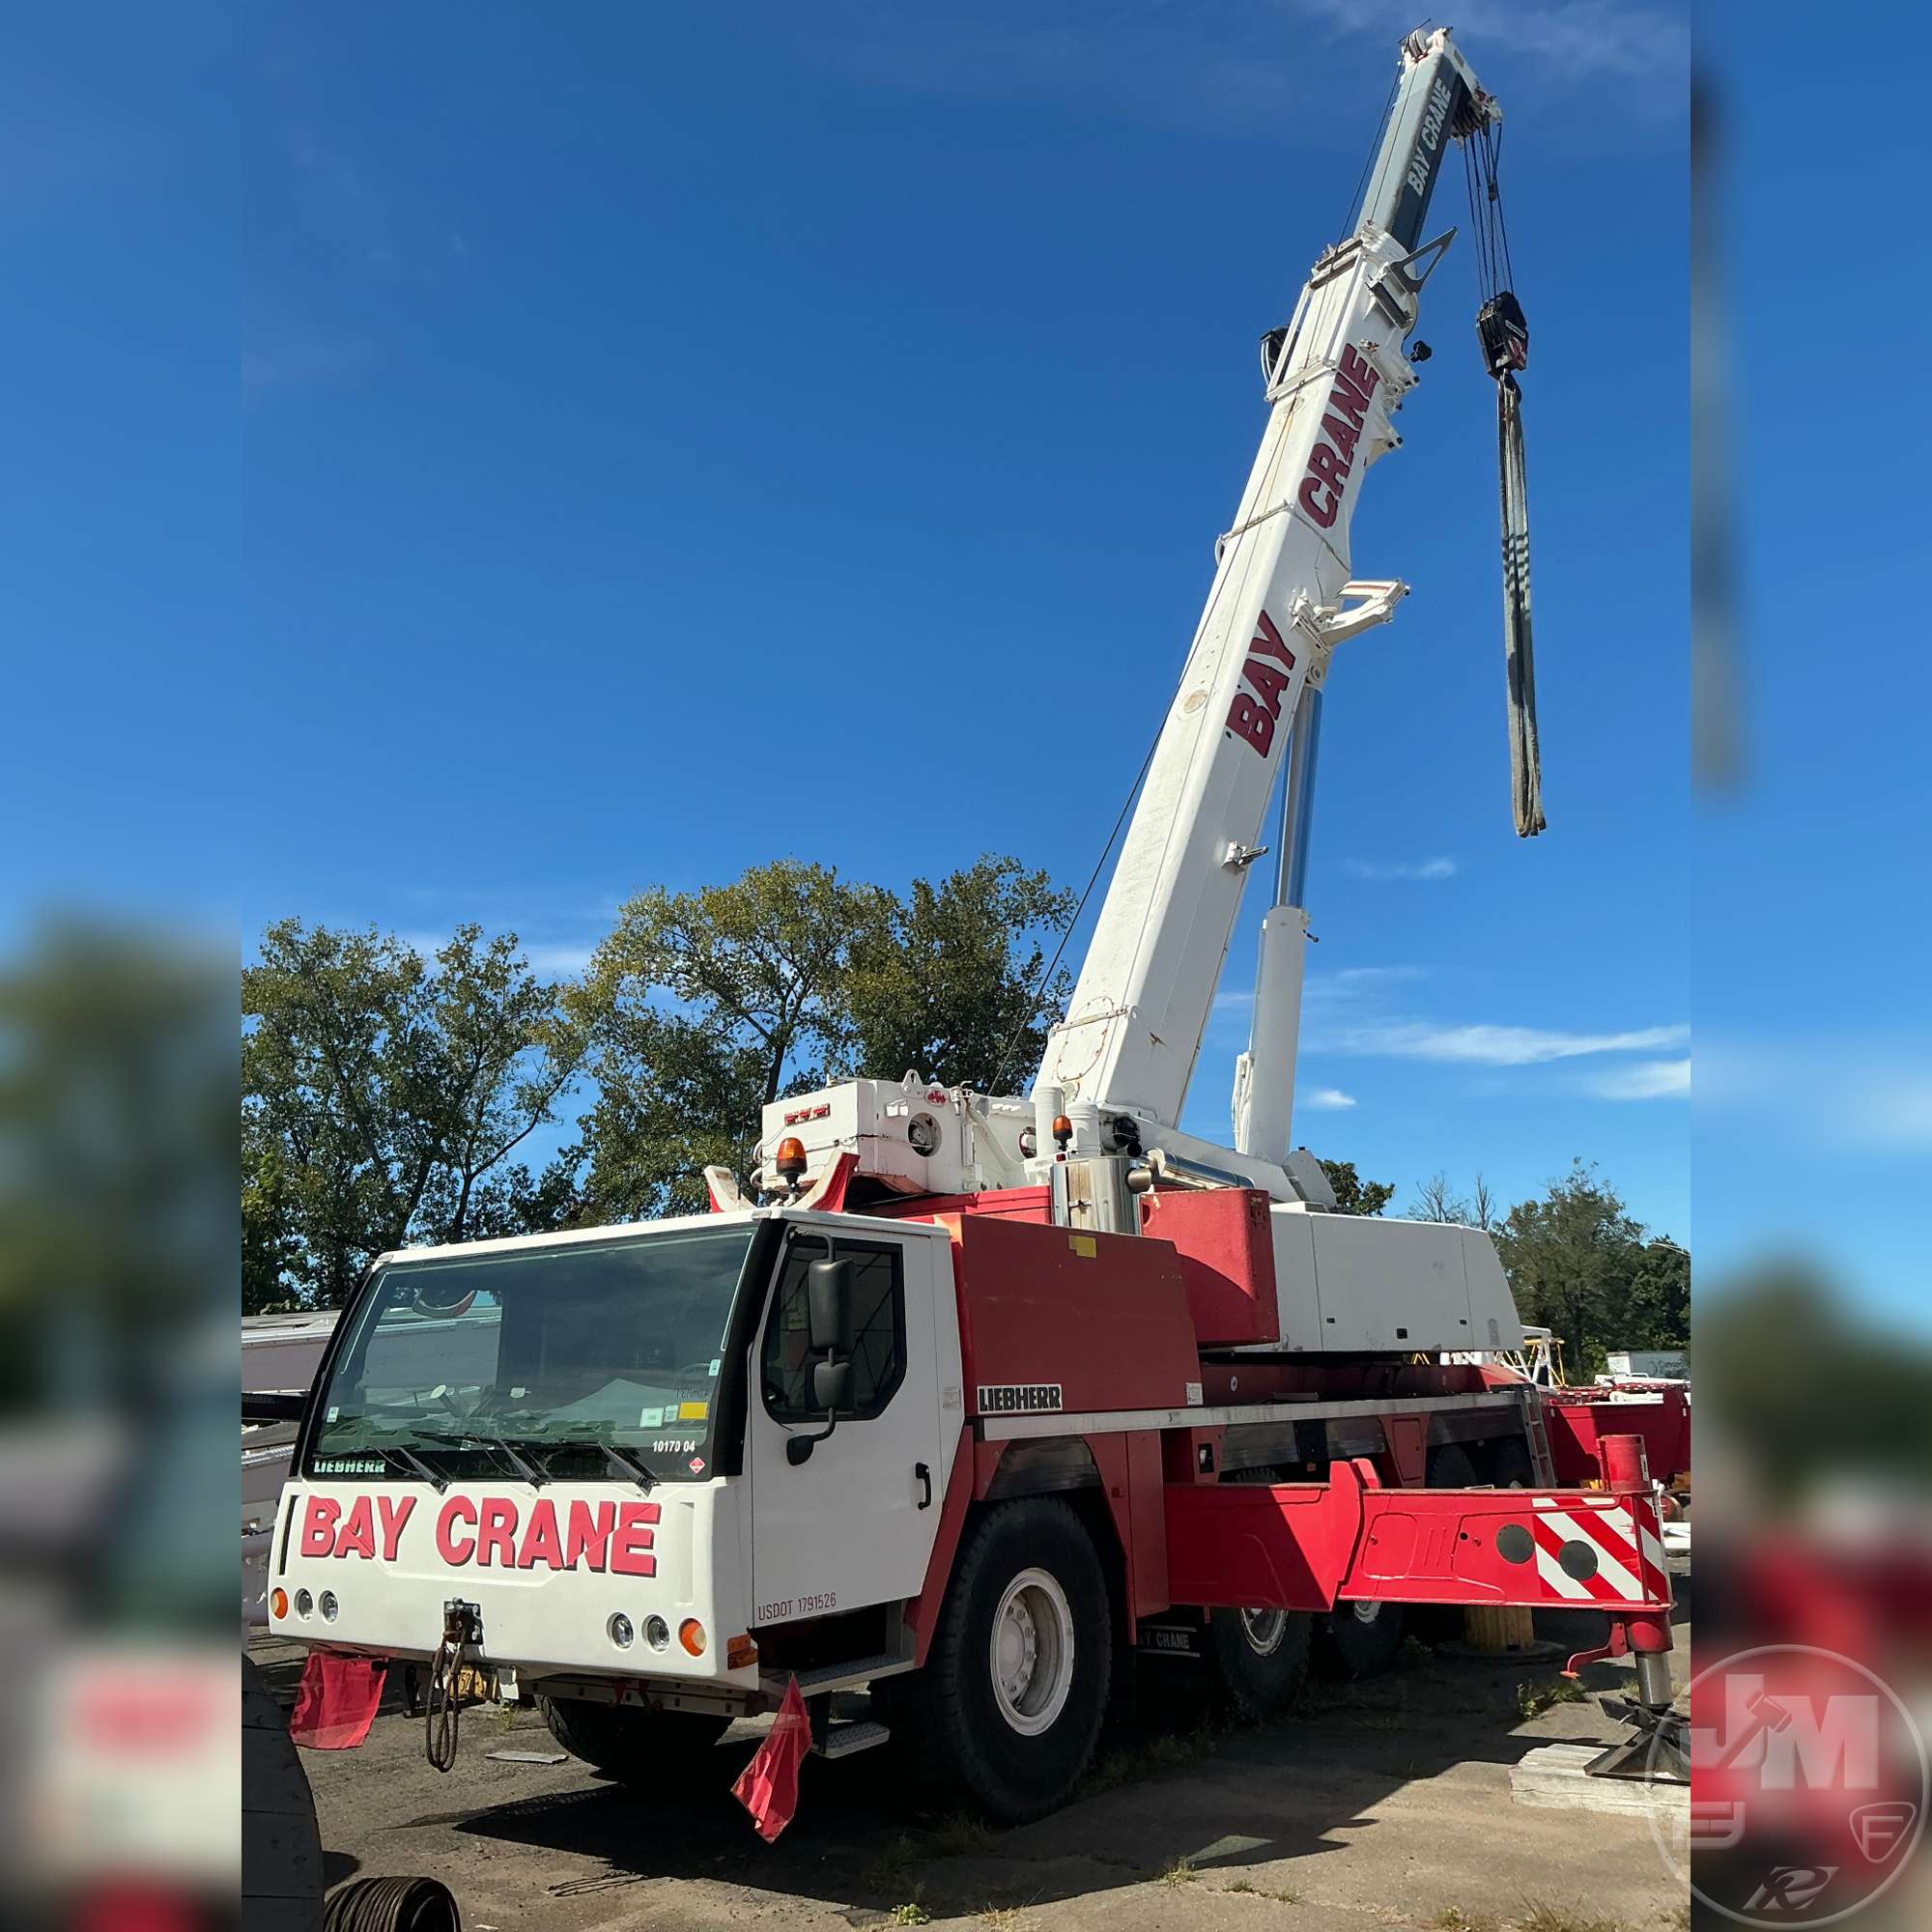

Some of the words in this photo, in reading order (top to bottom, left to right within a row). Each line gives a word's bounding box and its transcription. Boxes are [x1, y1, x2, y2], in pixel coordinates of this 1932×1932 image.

[1407, 146, 1431, 197] BAY
[1421, 77, 1452, 151] CRANE
[1298, 343, 1380, 528] CRANE
[1225, 610, 1296, 758] BAY
[979, 1386, 1061, 1411] LIEBHERR
[652, 1440, 680, 1452] 10170
[683, 1440, 696, 1452] 04
[300, 1495, 416, 1561] BAY
[436, 1495, 661, 1577] CRANE
[758, 1600, 793, 1620] USDOT
[798, 1591, 837, 1612] 1791526
